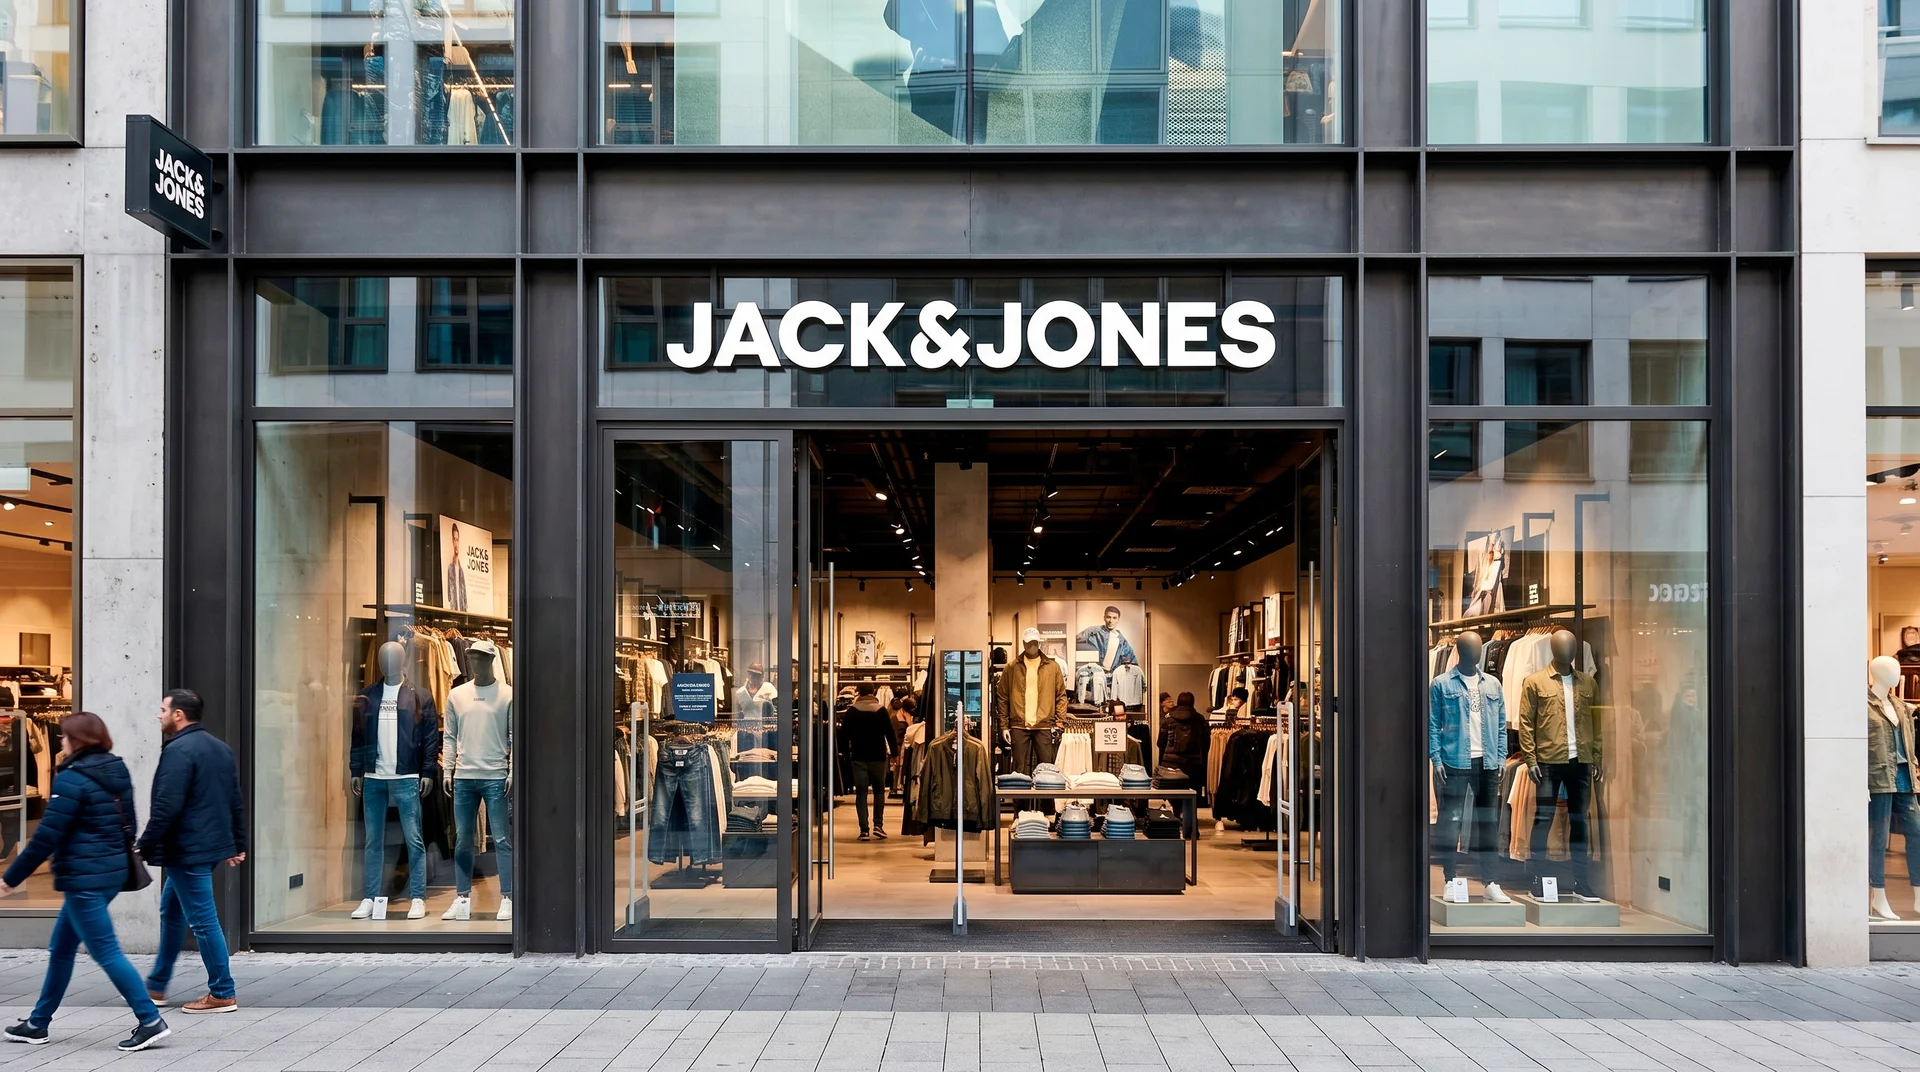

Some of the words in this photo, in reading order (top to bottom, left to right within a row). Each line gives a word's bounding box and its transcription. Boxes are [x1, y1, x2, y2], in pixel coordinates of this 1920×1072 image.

[155, 148, 205, 197] JACK&
[155, 172, 204, 219] JONES
[666, 300, 1277, 369] JACK&JONES
[467, 545, 489, 561] JACK&
[467, 560, 489, 573] JONES
